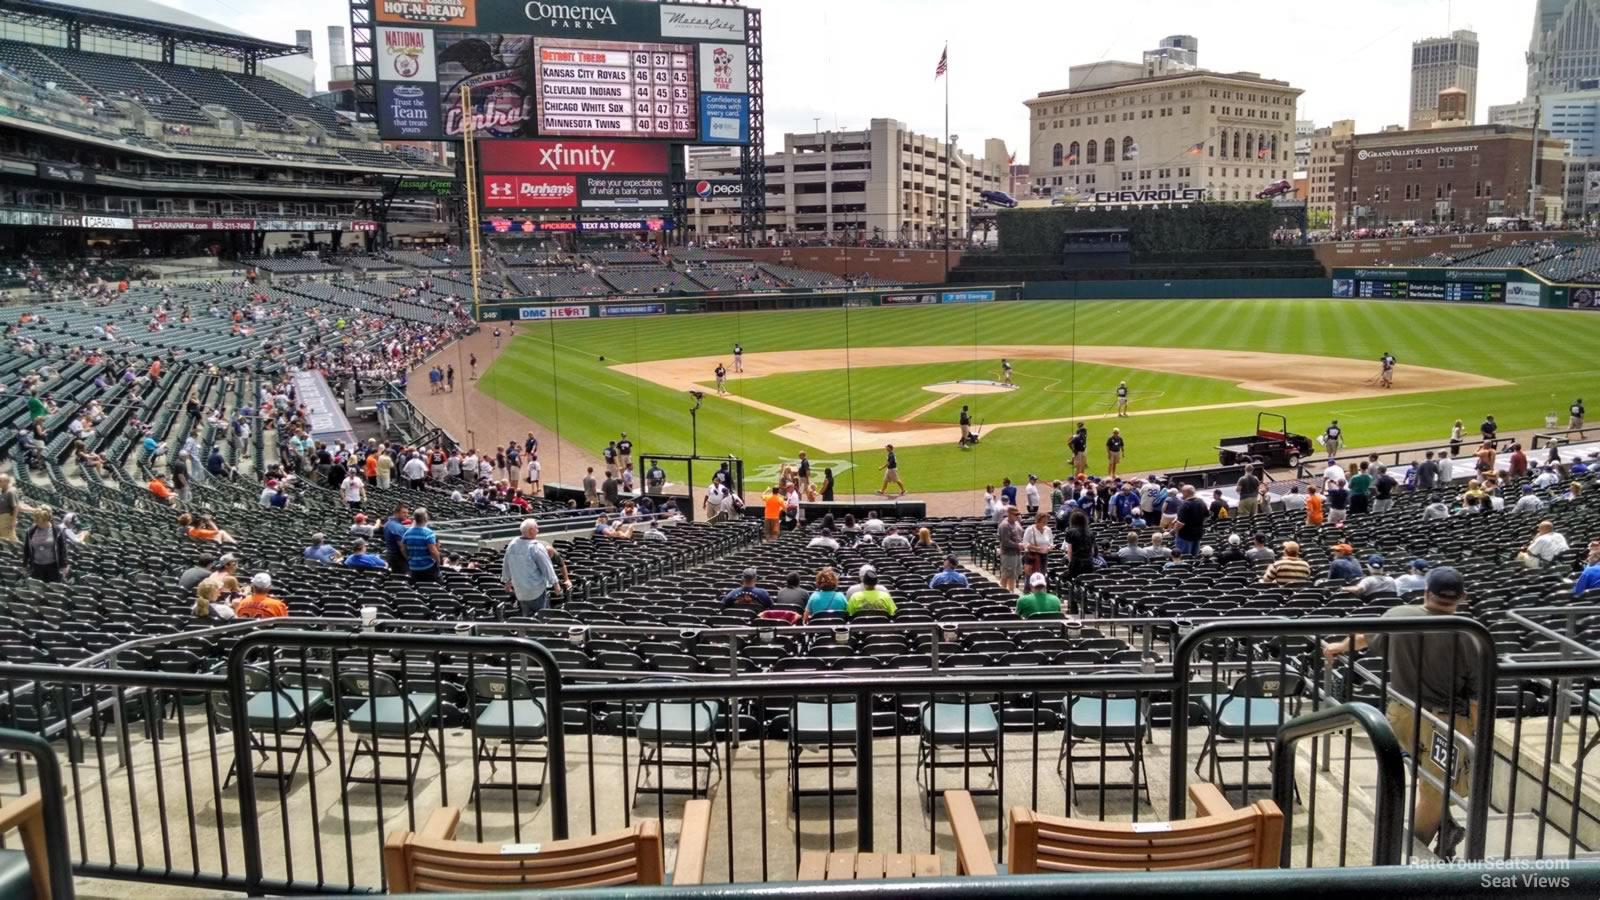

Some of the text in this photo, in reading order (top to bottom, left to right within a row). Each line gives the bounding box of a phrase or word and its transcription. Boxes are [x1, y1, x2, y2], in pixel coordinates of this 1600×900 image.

[384, 2, 466, 18] HOT-N-READY
[551, 19, 593, 29] PARK
[385, 31, 425, 48] NATIONAL
[543, 50, 606, 63] DETROIT TIGERS
[636, 54, 647, 64] 49
[655, 55, 666, 65] 37
[543, 68, 626, 80] KANSAS CITY ROYALS
[637, 71, 648, 80] 46
[656, 72, 667, 81] 43
[673, 72, 687, 82] 4.5
[543, 84, 622, 96] CLEVELAND INDIANS
[637, 88, 648, 97] 44
[656, 88, 668, 98] 45
[674, 89, 687, 98] 6.5
[393, 98, 425, 106] Trust the
[706, 95, 742, 103] Confidence
[390, 105, 428, 119] Team
[544, 101, 624, 113] CHICAGO WHITE SOX
[638, 103, 649, 113] 44
[657, 104, 668, 114] 47
[675, 105, 688, 114] 7.5
[706, 110, 724, 118] every
[408, 119, 428, 127] treats
[545, 118, 621, 129] MINNESOTA TWINS
[638, 120, 650, 129] 40
[658, 120, 669, 130] 49
[674, 121, 689, 130] 10.5
[1367, 145, 1479, 158] GRAND VALLEY STATE UNIVERSITY
[429, 180, 452, 190] Green
[587, 178, 663, 188] Raise your expectations
[520, 182, 574, 195] Dunham's
[589, 187, 596, 195] of
[598, 187, 613, 195] what
[621, 187, 637, 195] bank
[713, 183, 743, 195] pepsi
[1095, 188, 1205, 203] CHEVROLET
[1074, 203, 1188, 212] FOUNTAIN
[522, 309, 546, 317] DMC
